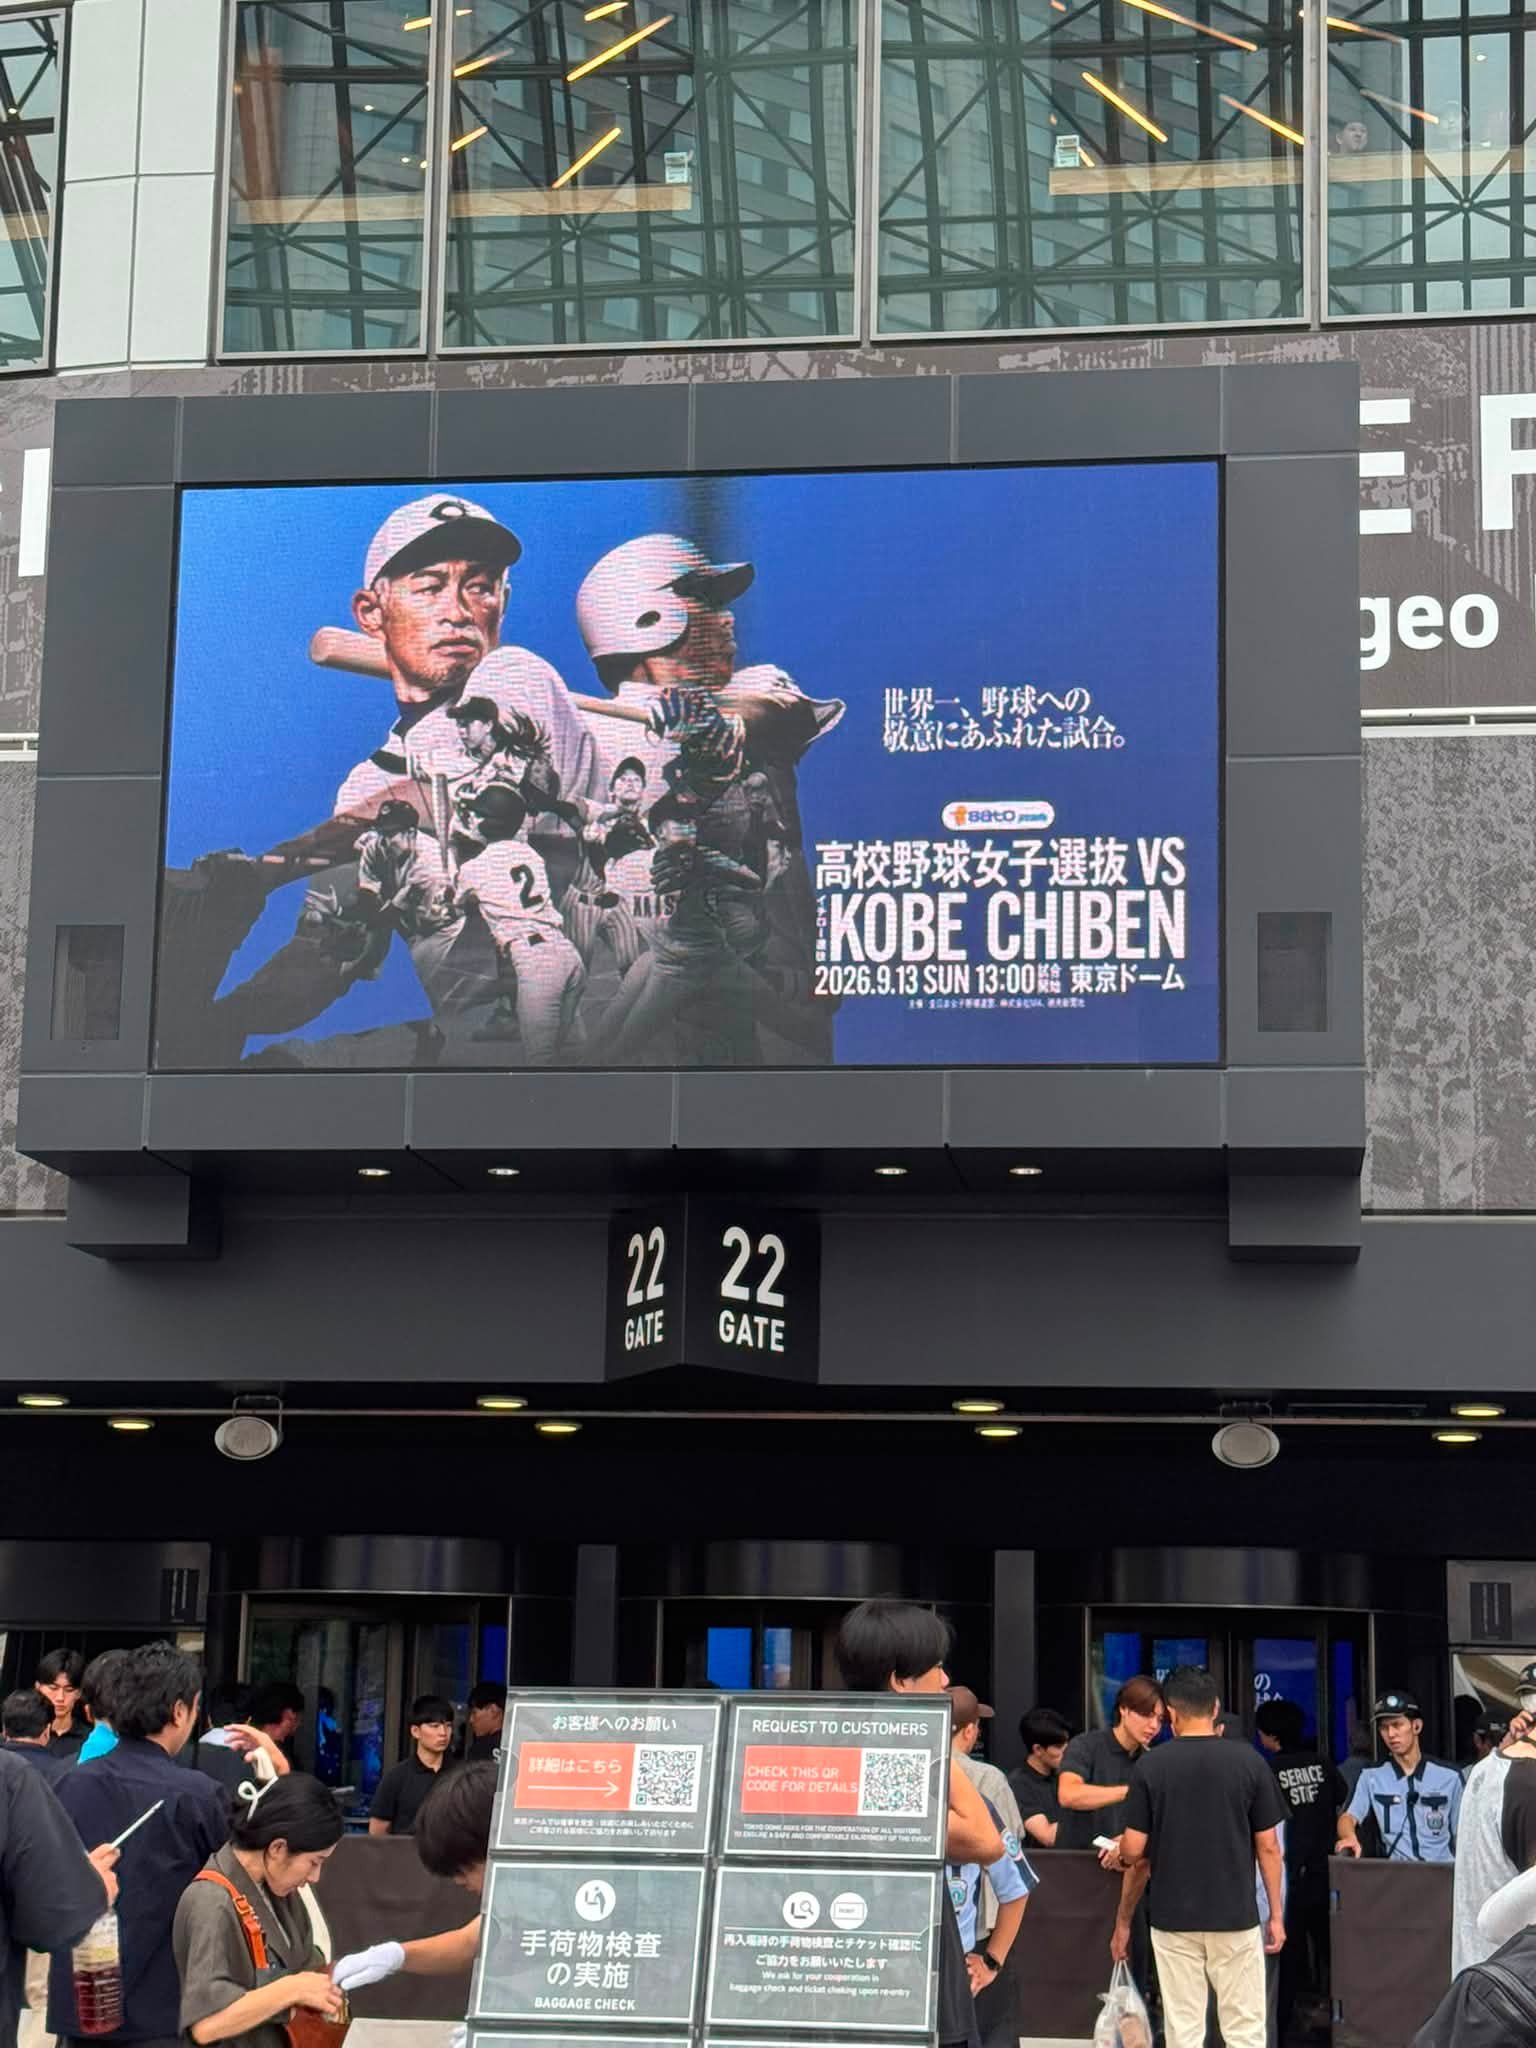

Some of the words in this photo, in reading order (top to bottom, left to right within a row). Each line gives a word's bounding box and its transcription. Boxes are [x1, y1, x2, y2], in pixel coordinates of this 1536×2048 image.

[883, 684, 1092, 719] 世界一、野球への
[882, 715, 1126, 752] 敬意にあふれた試合。
[815, 837, 1129, 890] 高校野球女子選抜
[1136, 836, 1187, 886] VS
[510, 863, 545, 909] 2
[829, 891, 968, 963] KOBE
[987, 889, 1186, 962] CHIBEN
[814, 963, 919, 996] 2026.9.13
[923, 963, 970, 995] SUN
[975, 962, 1036, 995] 13:00
[1069, 961, 1186, 994] 東京ドーム
[626, 1225, 666, 1307] 22
[720, 1225, 786, 1308] 22
[624, 1309, 665, 1352] GATE
[718, 1309, 786, 1353] GATE
[551, 1715, 678, 1733] お客様へのお願い
[752, 1719, 817, 1734] REQUEST
[820, 1720, 838, 1735] TO
[841, 1721, 929, 1737] CUSTOMERS
[527, 1756, 623, 1775] 詳細はこちら
[747, 1765, 788, 1778] CHECK
[793, 1766, 819, 1779] THIS
[822, 1767, 840, 1780] QR
[746, 1779, 778, 1793] CODE
[781, 1780, 805, 1794] FOR
[808, 1781, 858, 1794] DETAILS
[519, 1928, 662, 1959] 手荷物検査
[546, 1961, 631, 1990] の実施
[761, 1970, 776, 1980] We
[534, 1996, 592, 2010] BAGGAGE
[594, 1998, 637, 2011] CHECK
